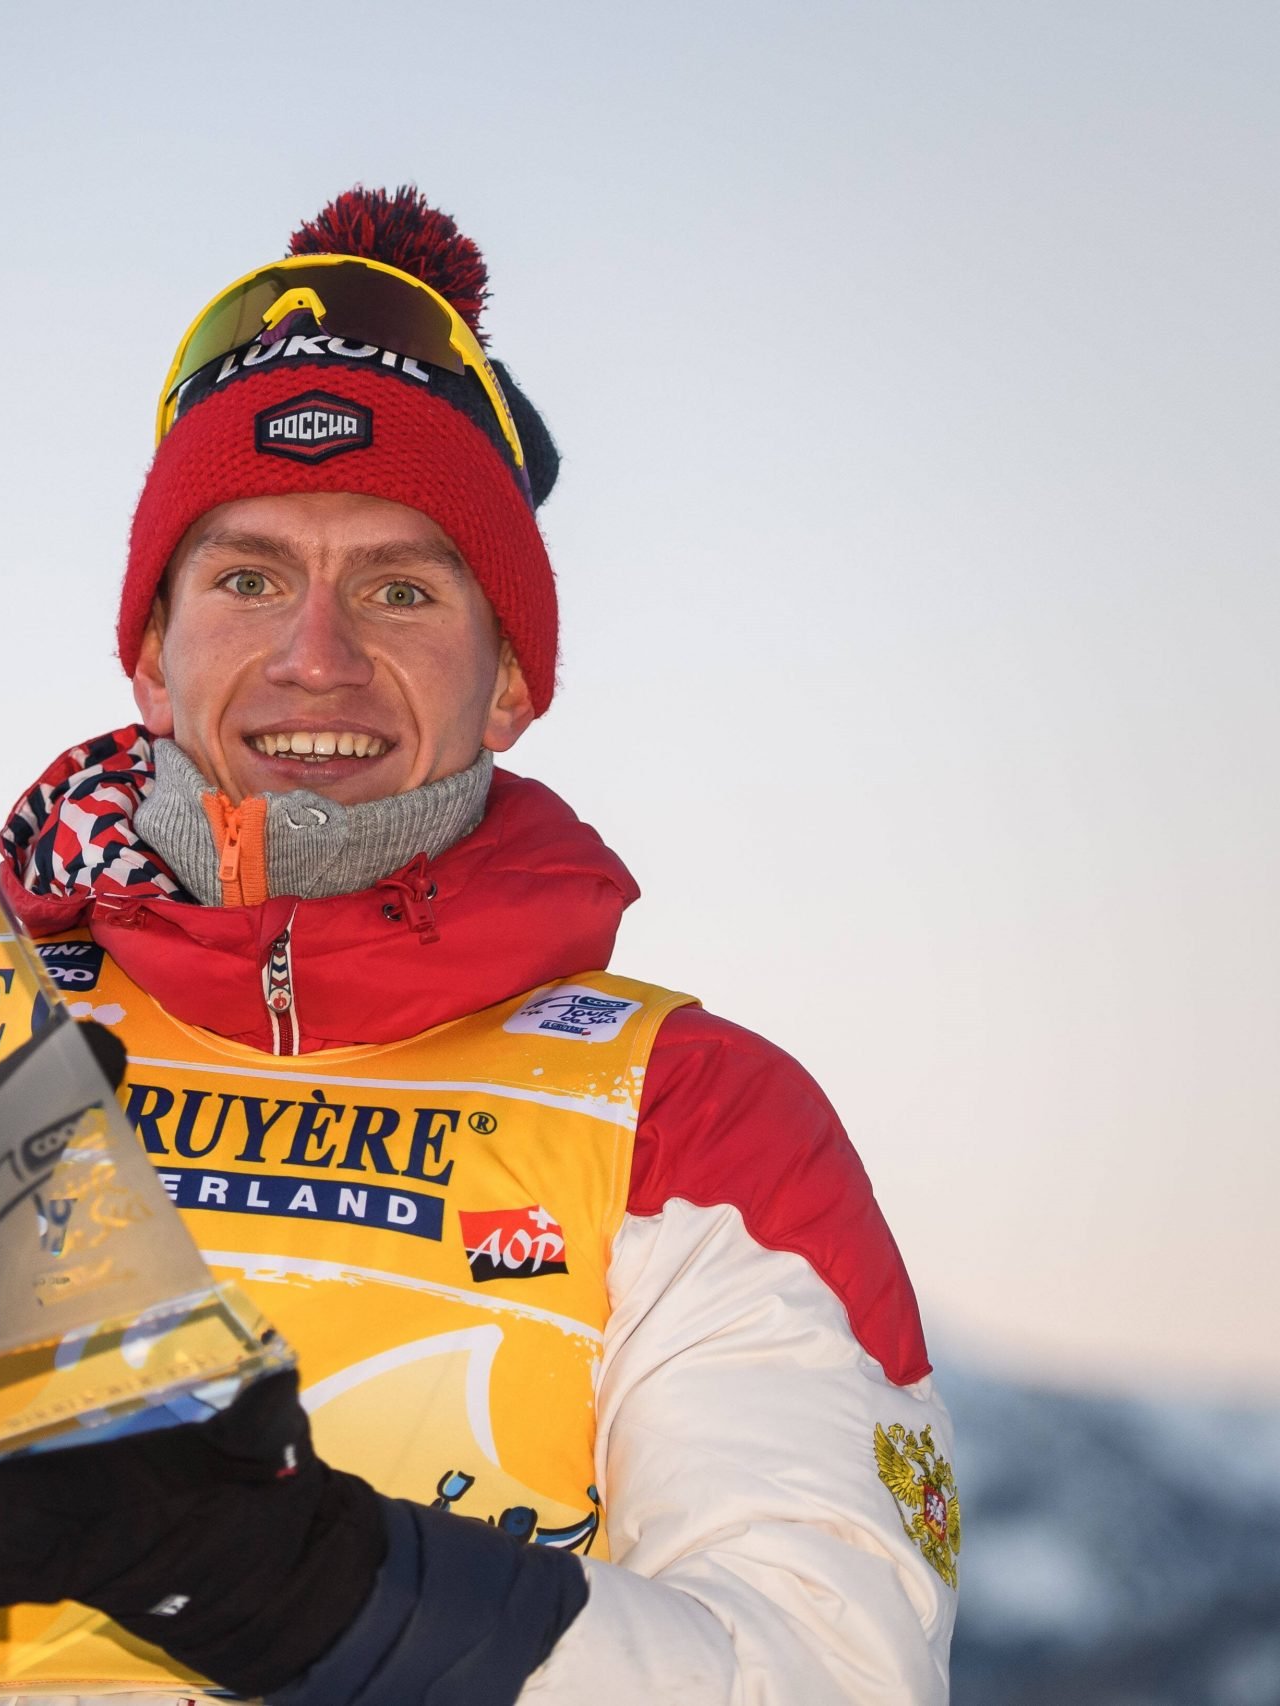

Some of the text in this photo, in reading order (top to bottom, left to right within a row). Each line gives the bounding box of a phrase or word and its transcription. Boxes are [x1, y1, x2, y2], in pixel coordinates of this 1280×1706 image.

[124, 1083, 462, 1187] RUYÈRE
[158, 1173, 418, 1226] ERLAND
[466, 1227, 565, 1274] AOP
